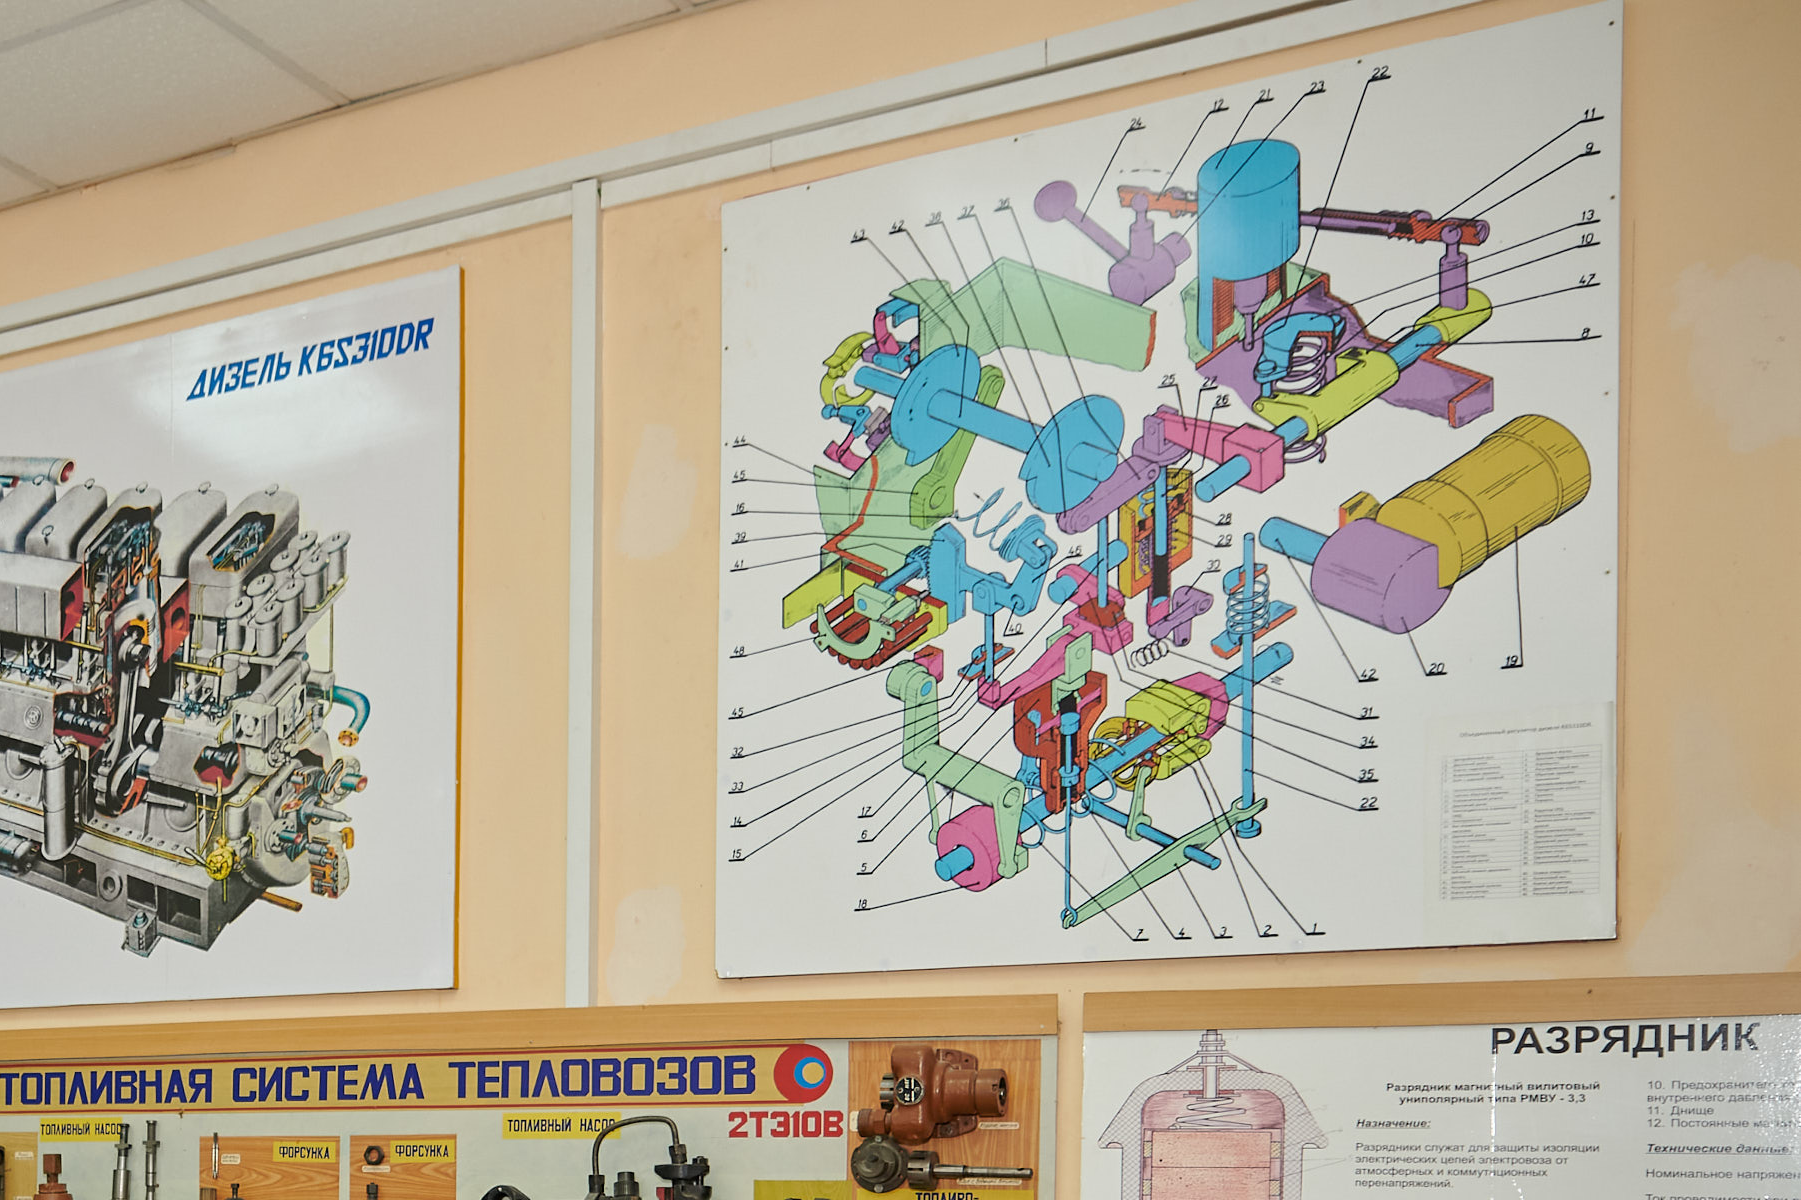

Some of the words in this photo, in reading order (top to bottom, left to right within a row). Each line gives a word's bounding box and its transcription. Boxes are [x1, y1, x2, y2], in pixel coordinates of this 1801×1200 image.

[1372, 66, 1389, 79] 22
[1310, 80, 1325, 93] 23
[1259, 89, 1270, 101] 21
[1584, 108, 1595, 119] 11
[1585, 142, 1594, 155] 9
[1581, 233, 1594, 245] 10
[1579, 274, 1595, 285] 47
[186, 351, 292, 401] ДИЗЕЛЬ
[734, 560, 744, 568] 41
[1505, 655, 1518, 666] 19
[1361, 669, 1376, 679] 42
[732, 707, 744, 717] 45
[1359, 768, 1374, 780] 35
[1360, 797, 1377, 808] 22
[861, 807, 871, 816] 17
[732, 849, 741, 858] 15
[858, 900, 867, 908] 18
[1491, 1022, 1760, 1058] РАЗРЯДНИК
[0, 1068, 213, 1106] ТОПЛИВНАЯ
[232, 1062, 425, 1103] СИСТЕМА
[448, 1055, 756, 1099] ТЕПЛОВОЗОВ
[1386, 1082, 1450, 1092] Разрядник
[1527, 1081, 1601, 1092] вилитовый
[1399, 1095, 1484, 1105] униполярный
[1488, 1095, 1517, 1104] типа
[1520, 1094, 1556, 1103] РМВУ
[1568, 1094, 1586, 1104] 3,3
[1647, 1094, 1725, 1103] внутреннего
[1670, 1106, 1714, 1116] Днище
[40, 1122, 91, 1136] ТОПЛИВНЫЙ
[507, 1117, 572, 1134] ТОПЛИВНЫЙ
[728, 1110, 844, 1138] 2ТЭ10В
[1356, 1119, 1431, 1128] Назначение:
[1671, 1119, 1749, 1128] Постоянные
[279, 1146, 330, 1160] ФОРСУНКА
[395, 1145, 449, 1157] ФОРСУНКА
[1355, 1143, 1421, 1153] Разрядники
[1424, 1143, 1465, 1153] служат
[1543, 1144, 1600, 1153] изоляции
[1647, 1144, 1732, 1154] Технические
[1355, 1156, 1437, 1165] электрических
[1441, 1155, 1475, 1165] цепей
[1479, 1156, 1552, 1165] электровоза
[1355, 1167, 1432, 1177] атмосферных
[1447, 1168, 1548, 1178] коммутационных
[1646, 1169, 1733, 1179] Номинальное
[1737, 1171, 1801, 1180] напряжен
